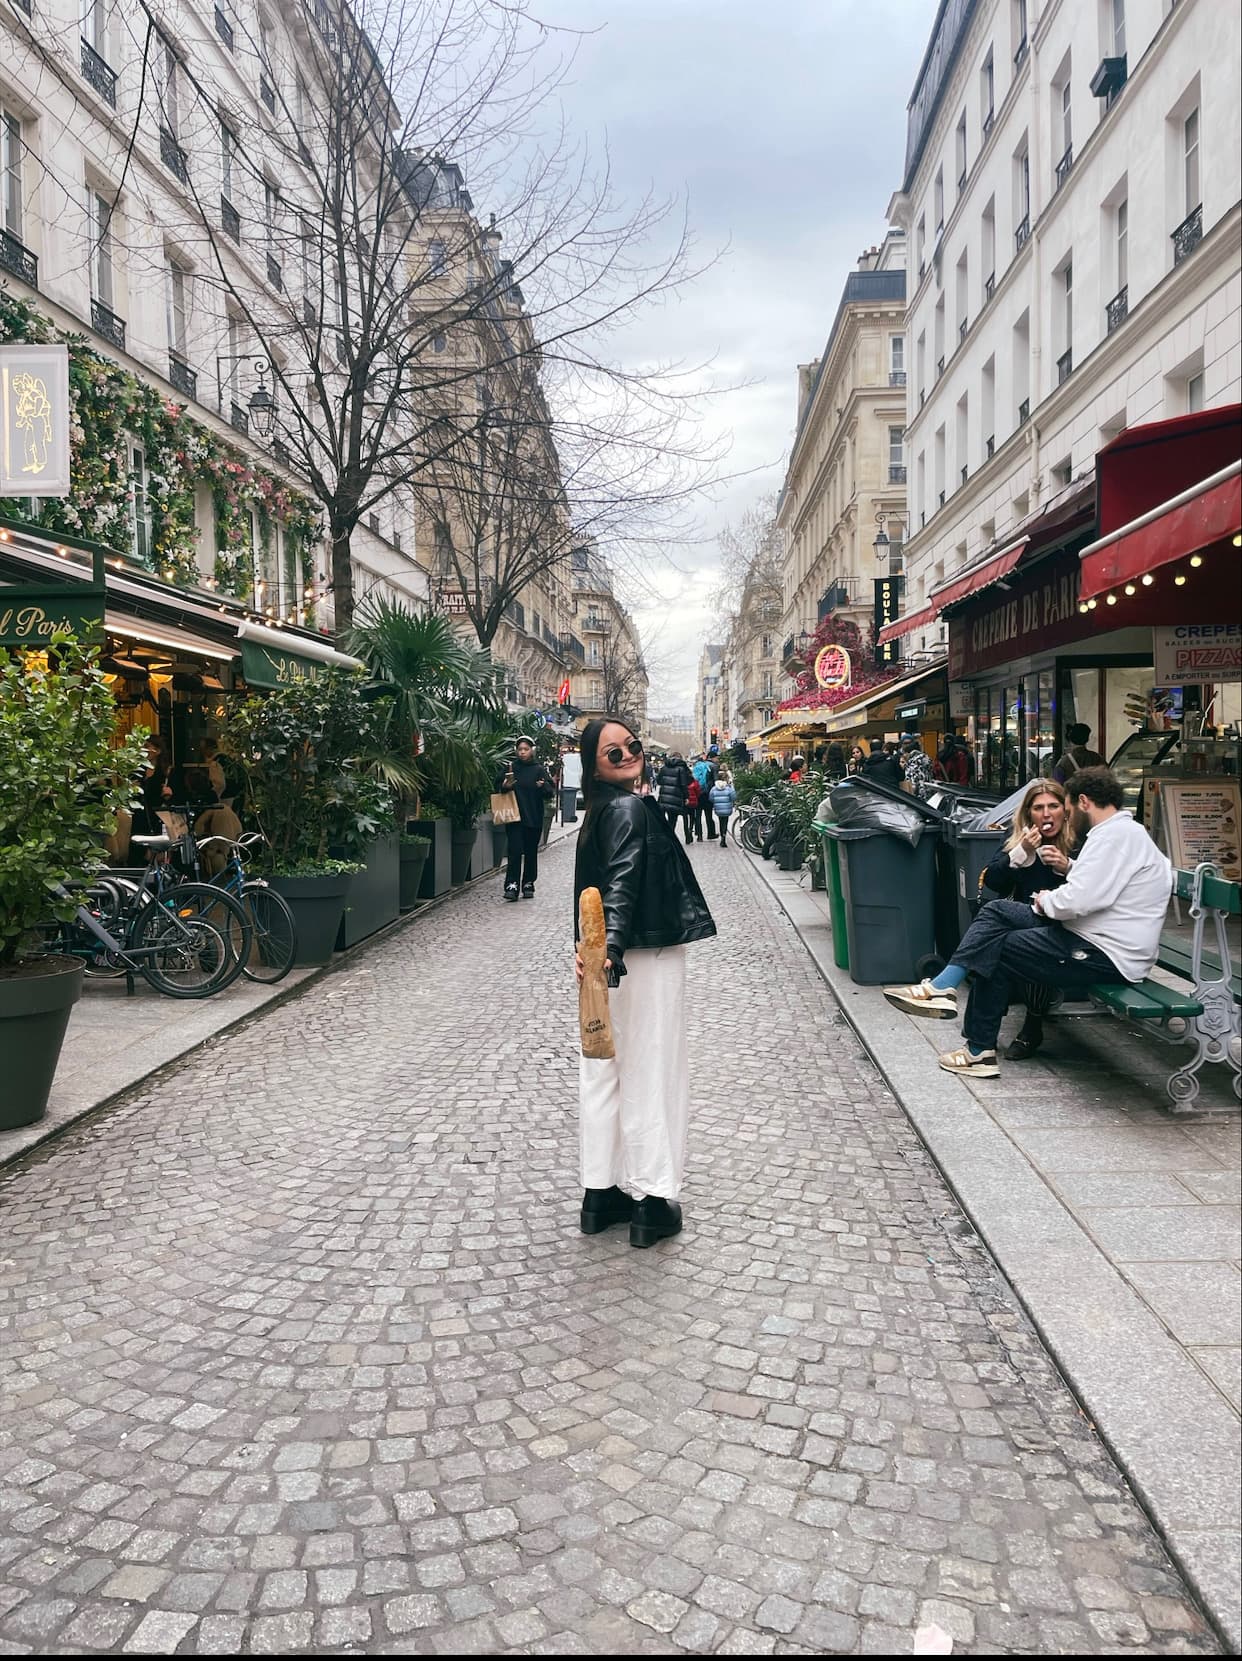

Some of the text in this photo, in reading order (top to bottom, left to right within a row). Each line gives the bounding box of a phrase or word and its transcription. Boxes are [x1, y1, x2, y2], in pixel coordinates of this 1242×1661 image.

[15, 606, 75, 637] Paris
[882, 583, 891, 660] BOULAER
[1022, 589, 1039, 634] DE
[1175, 624, 1241, 638] CREPE
